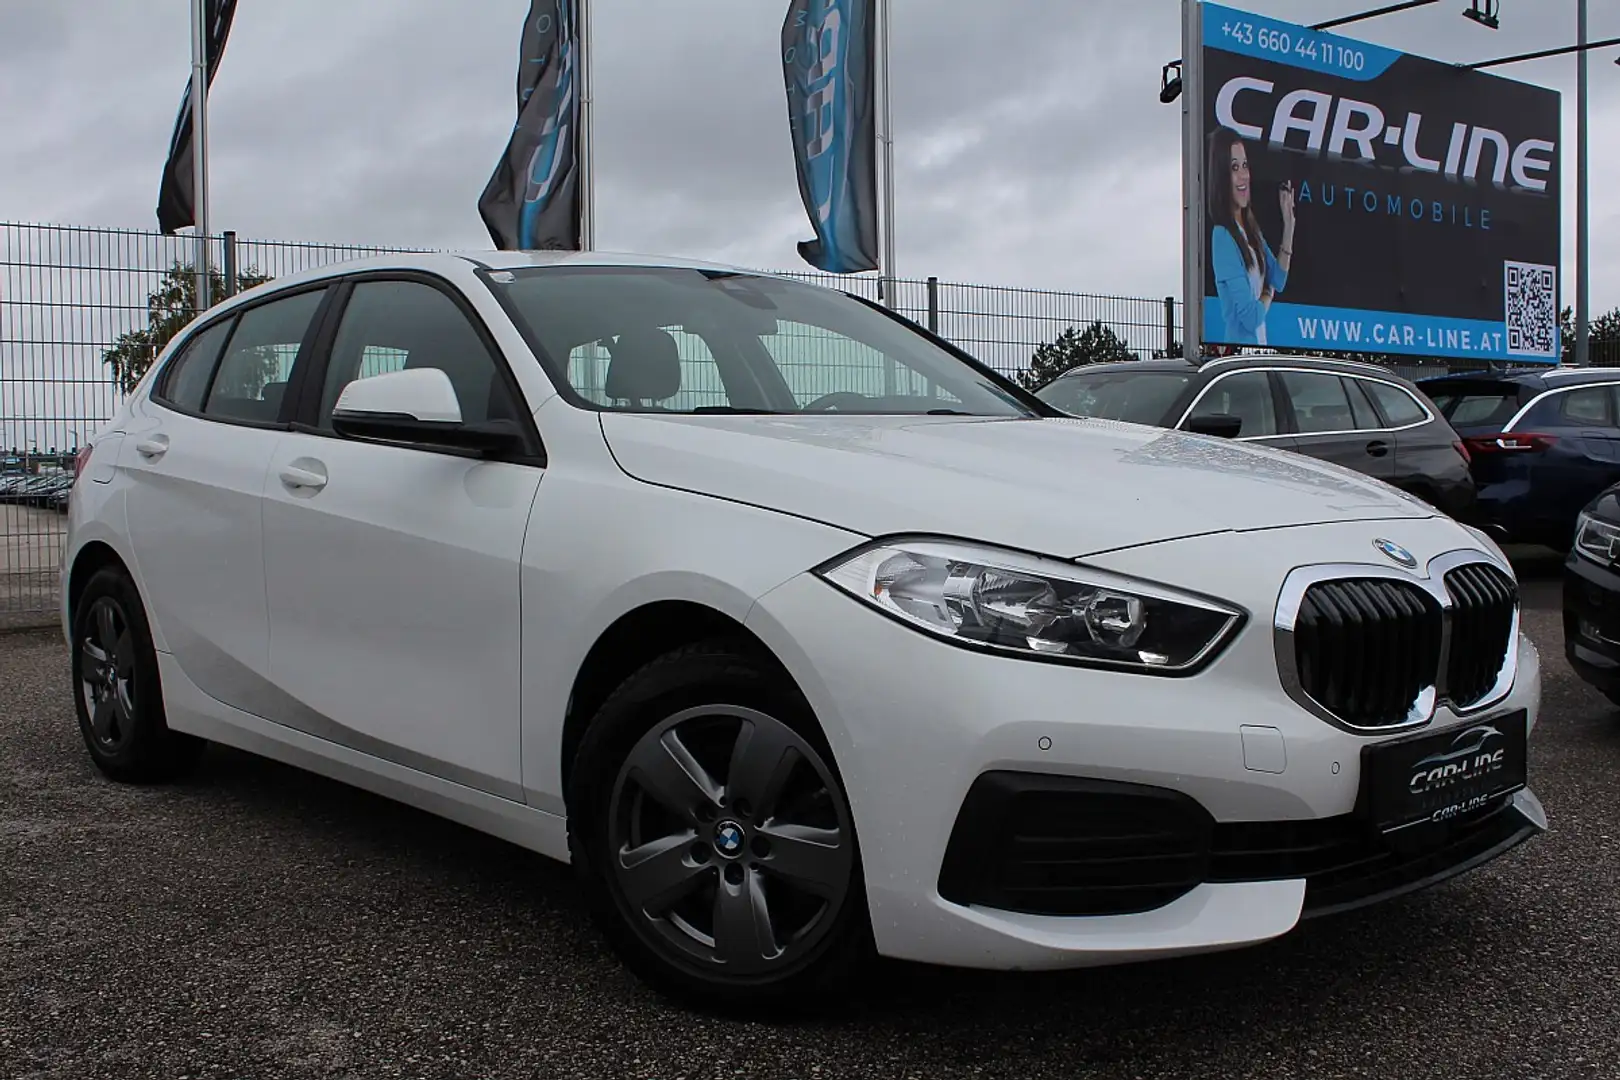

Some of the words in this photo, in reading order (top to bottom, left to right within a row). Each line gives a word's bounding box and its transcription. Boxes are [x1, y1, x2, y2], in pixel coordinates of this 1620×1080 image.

[1222, 21, 1253, 45] +43
[1258, 28, 1290, 53] 660
[1295, 37, 1317, 61] 44
[1321, 43, 1333, 64] 11
[1337, 46, 1364, 71] 100
[1215, 76, 1555, 192] CAR-LINE
[1299, 179, 1491, 230] AUTOMOBILE
[1298, 316, 1502, 352] WWW.CAR-LINE.AT
